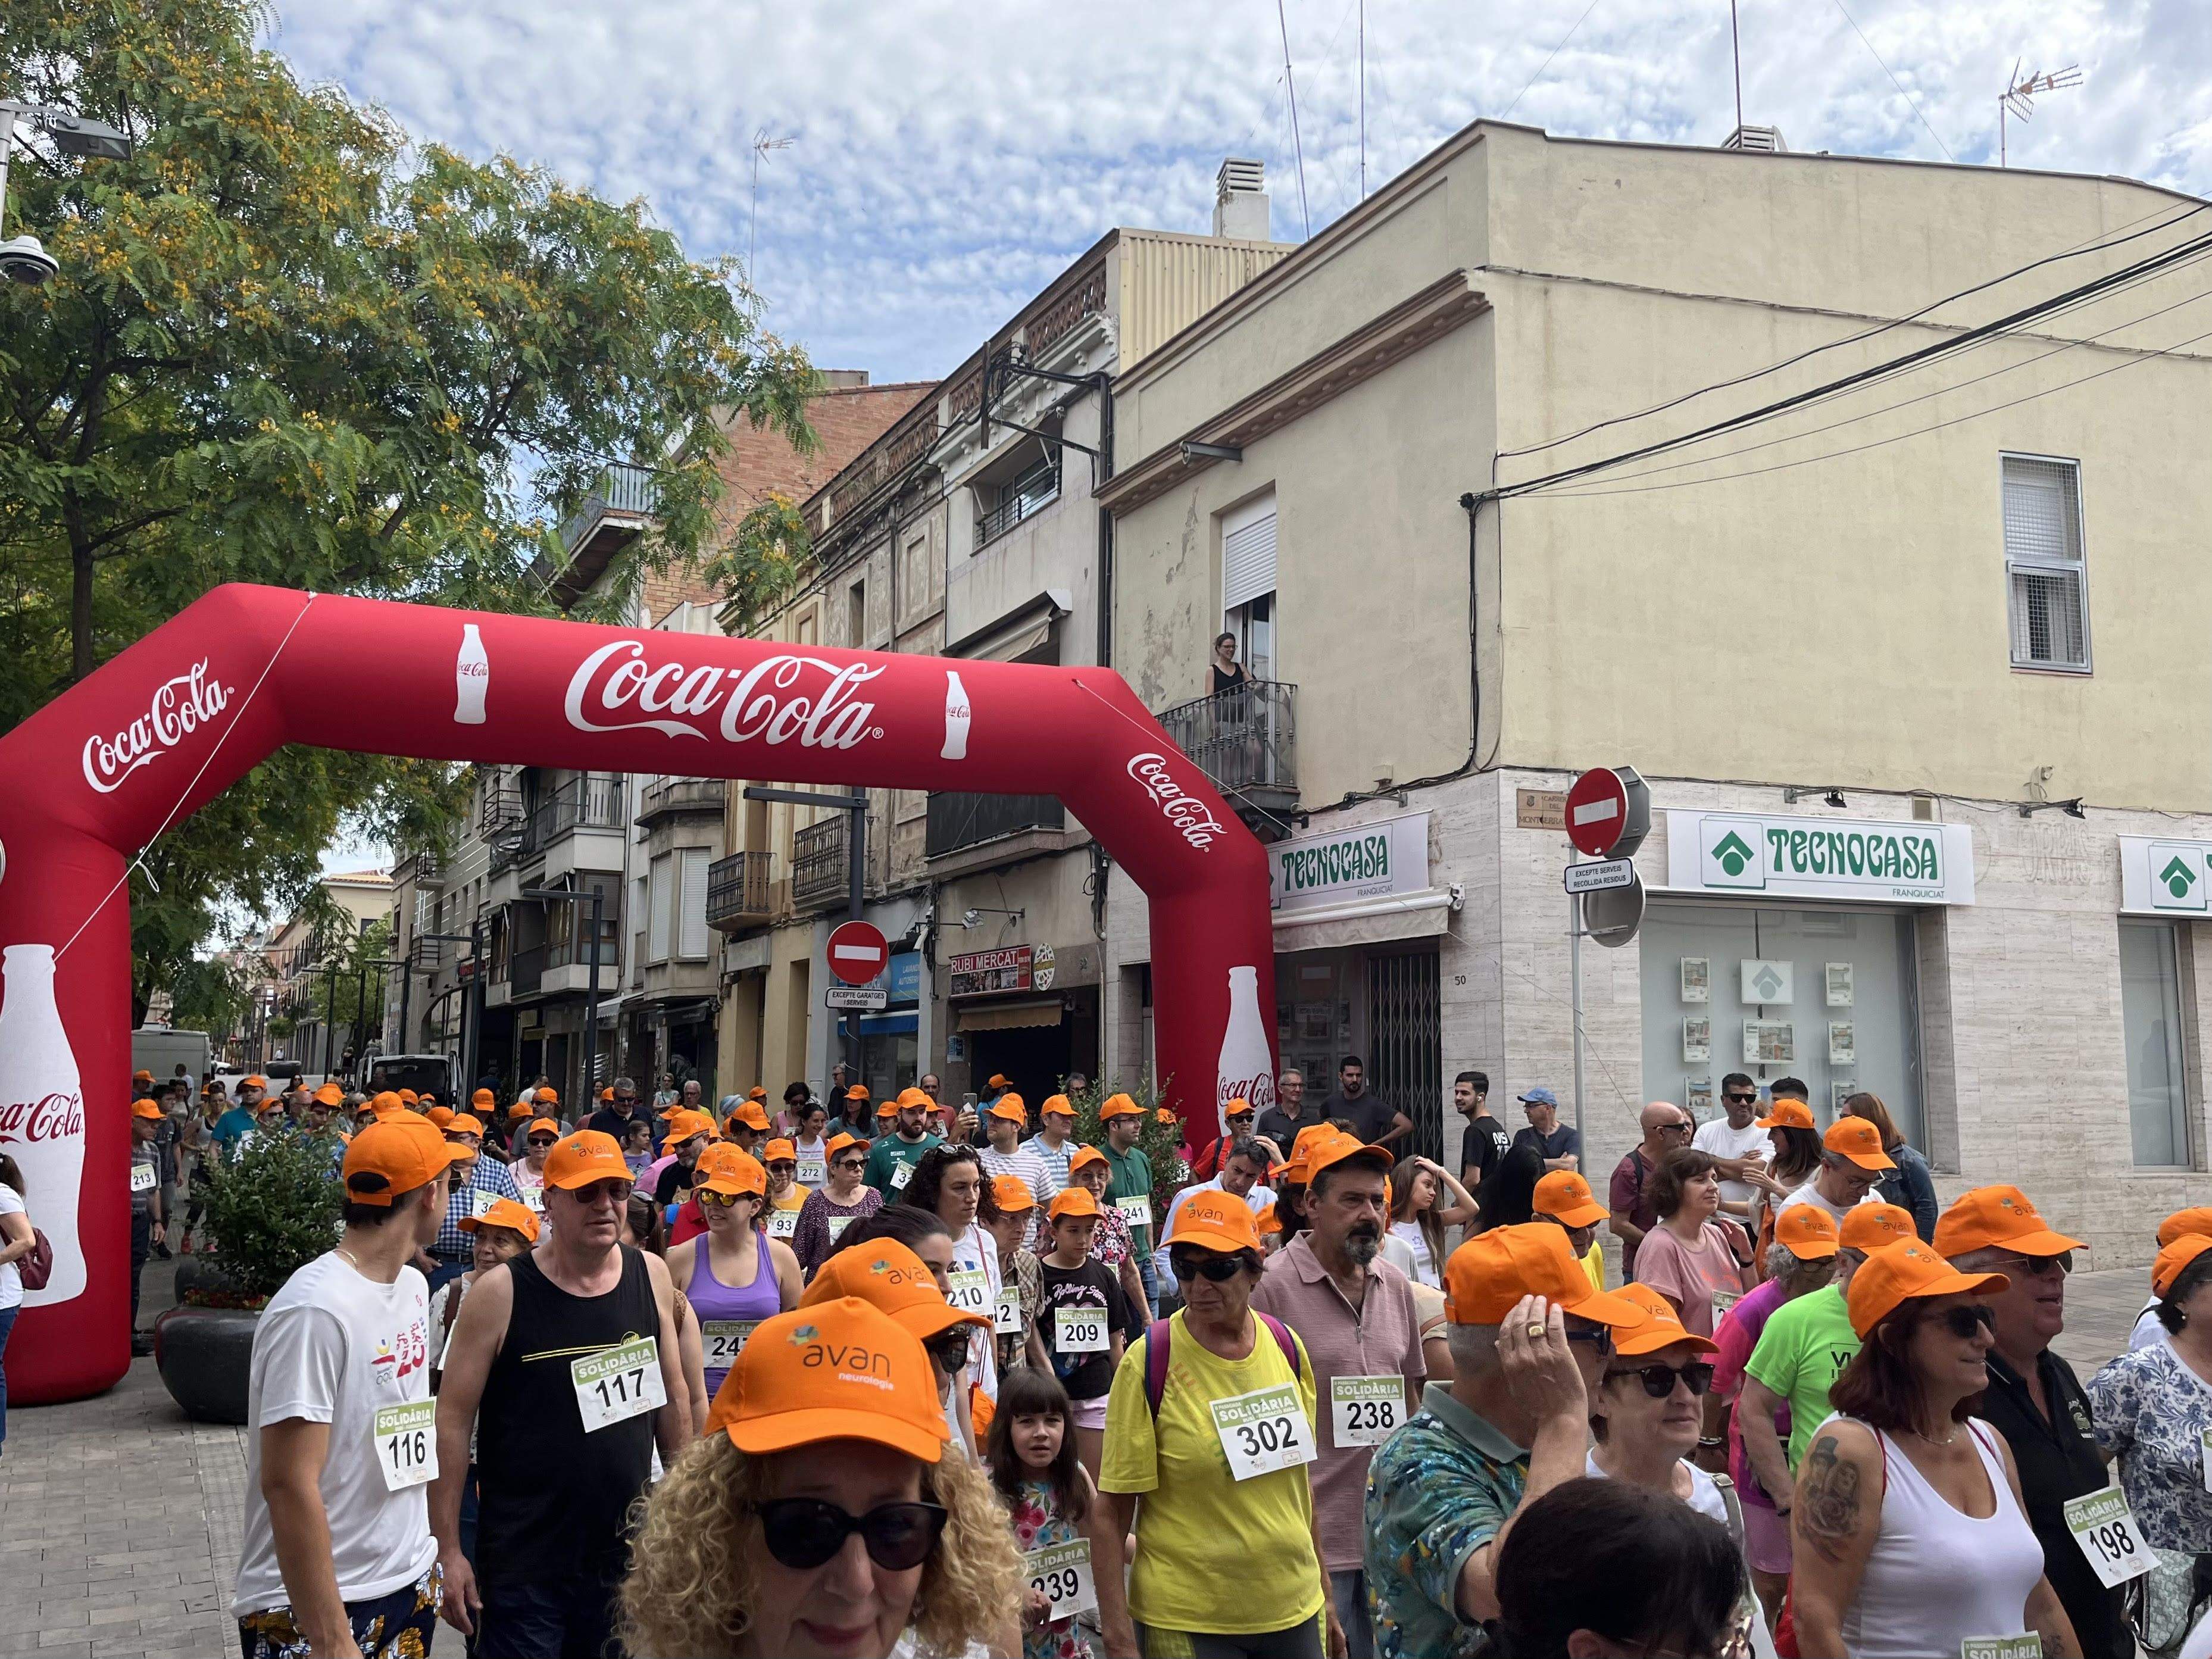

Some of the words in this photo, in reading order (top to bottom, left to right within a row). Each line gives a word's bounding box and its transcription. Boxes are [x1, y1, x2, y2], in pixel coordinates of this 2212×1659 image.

[564, 641, 887, 750] Coca-Cola
[83, 656, 227, 793] Coca-Cola
[1127, 753, 1227, 848] Coca-Cola
[1282, 835, 1388, 891] TECNOCASA
[1767, 829, 1938, 880] TECNOCASA
[1573, 879, 1602, 888] RECOLLIDA
[1604, 874, 1626, 884] RESIDUS
[1576, 868, 1599, 877] EXCEPTE
[1600, 865, 1621, 874] SERVEIS
[1357, 884, 1393, 897] FRANQUICIAT
[1892, 888, 1945, 898] FRANQUICIAT
[951, 958, 973, 973] RUBI
[976, 951, 1018, 969] MERCAT
[1455, 975, 1466, 986] 50
[579, 1144, 611, 1158] avan
[133, 1173, 151, 1185] 213
[802, 1169, 818, 1177] 272
[1124, 1207, 1144, 1219] 241
[1188, 1208, 1224, 1220] avan
[776, 1220, 792, 1231] 93
[948, 1287, 982, 1307] 210
[1058, 1311, 1104, 1320] SOLIDÀRIA
[1065, 1324, 1098, 1342] 209
[579, 1348, 652, 1379] SOLIDÀRIA
[803, 1344, 891, 1377] avan
[595, 1368, 644, 1408] 117
[1336, 1382, 1399, 1395] SOLIDÀRIA
[379, 1408, 432, 1429] SOLIDÀRIA
[1219, 1395, 1295, 1422] SOLIDÀRIA
[1346, 1401, 1394, 1430] 238
[1236, 1417, 1299, 1457] 302
[389, 1430, 426, 1469] 116
[2068, 1497, 2123, 1526] SOLIDÀRIA
[2089, 1521, 2135, 1563] 198
[1028, 1548, 1086, 1571] OLIDÀRIA
